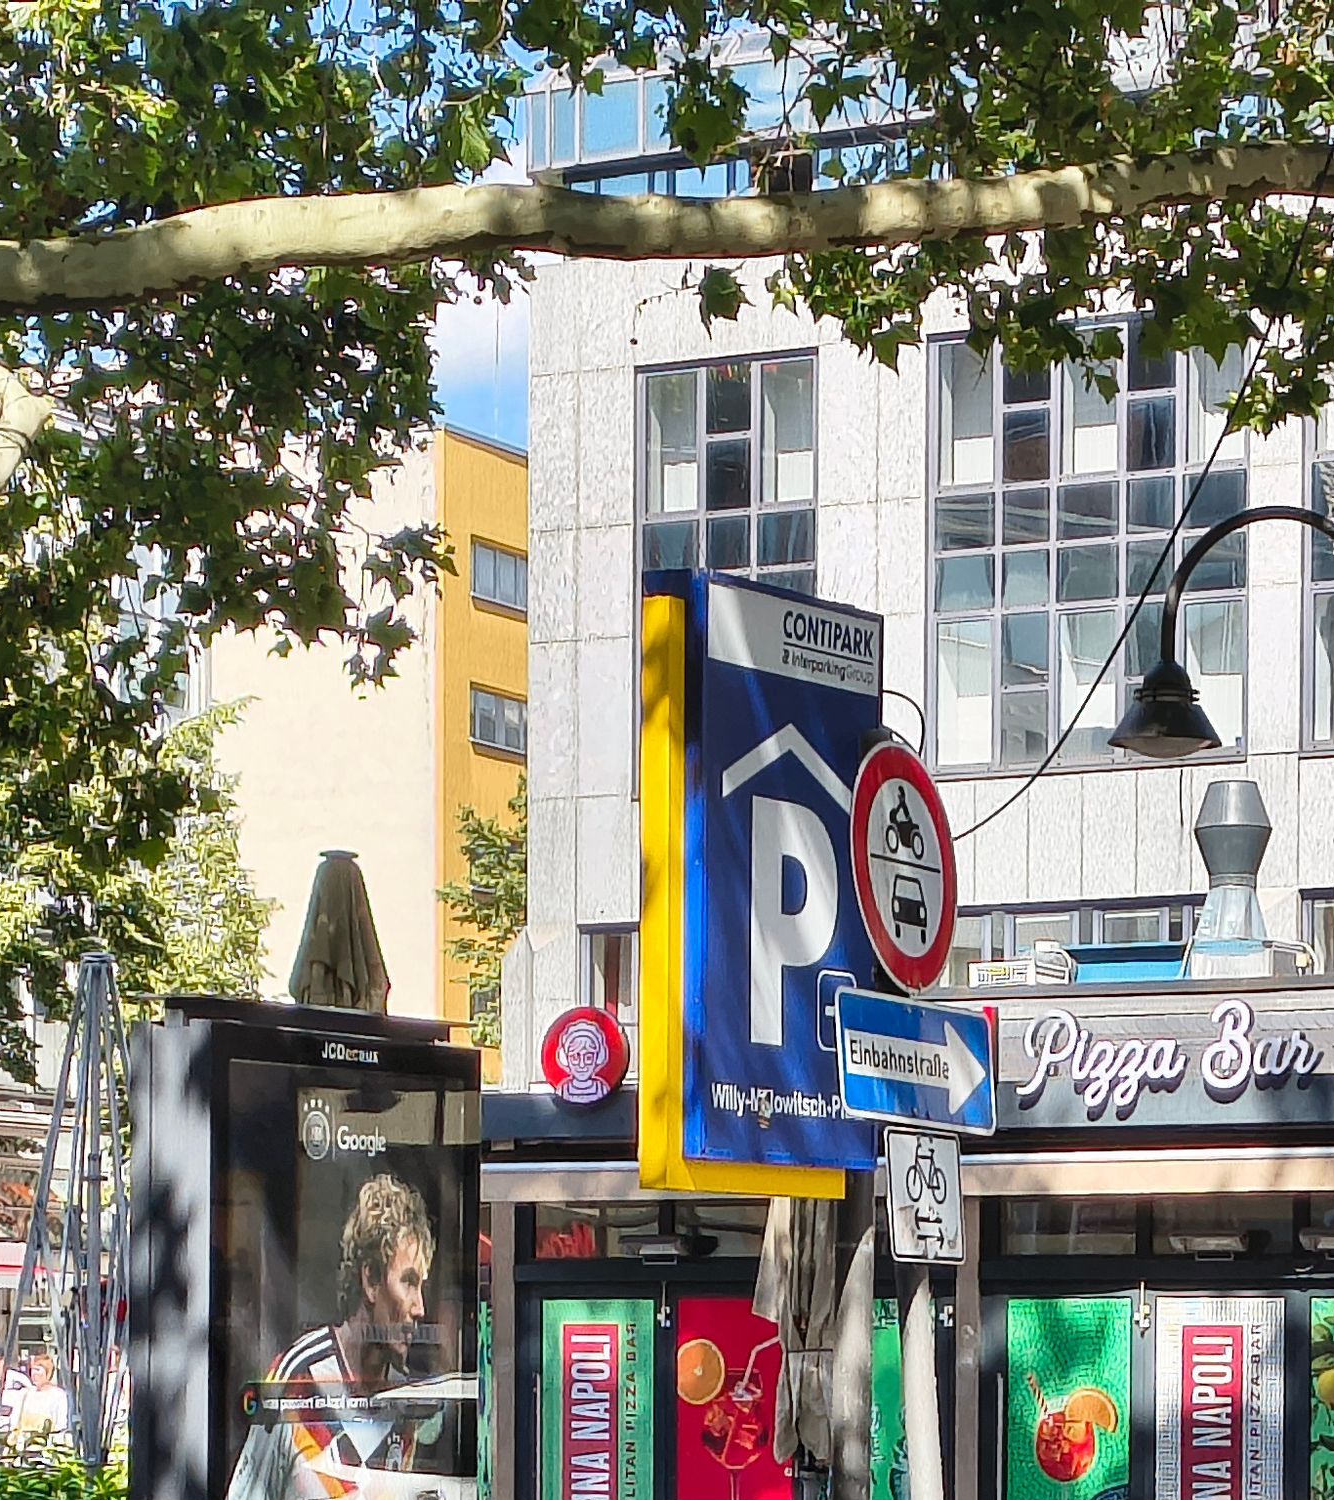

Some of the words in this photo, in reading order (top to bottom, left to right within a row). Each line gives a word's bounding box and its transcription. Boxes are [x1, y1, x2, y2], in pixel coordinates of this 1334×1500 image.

[783, 610, 874, 659] CONTIPARK
[750, 796, 839, 1047] P
[850, 1039, 950, 1080] Einbahnstraße
[1016, 1008, 1188, 1109] Pizza
[1200, 998, 1323, 1090] Bar
[337, 1125, 387, 1157] Google
[624, 1322, 638, 1362] BAR
[1250, 1323, 1264, 1364] BAR
[570, 1333, 612, 1441] NAPOLI
[624, 1370, 637, 1432] PIZZA
[1191, 1335, 1235, 1448] NAPOLI
[1250, 1376, 1263, 1437] PIZZA
